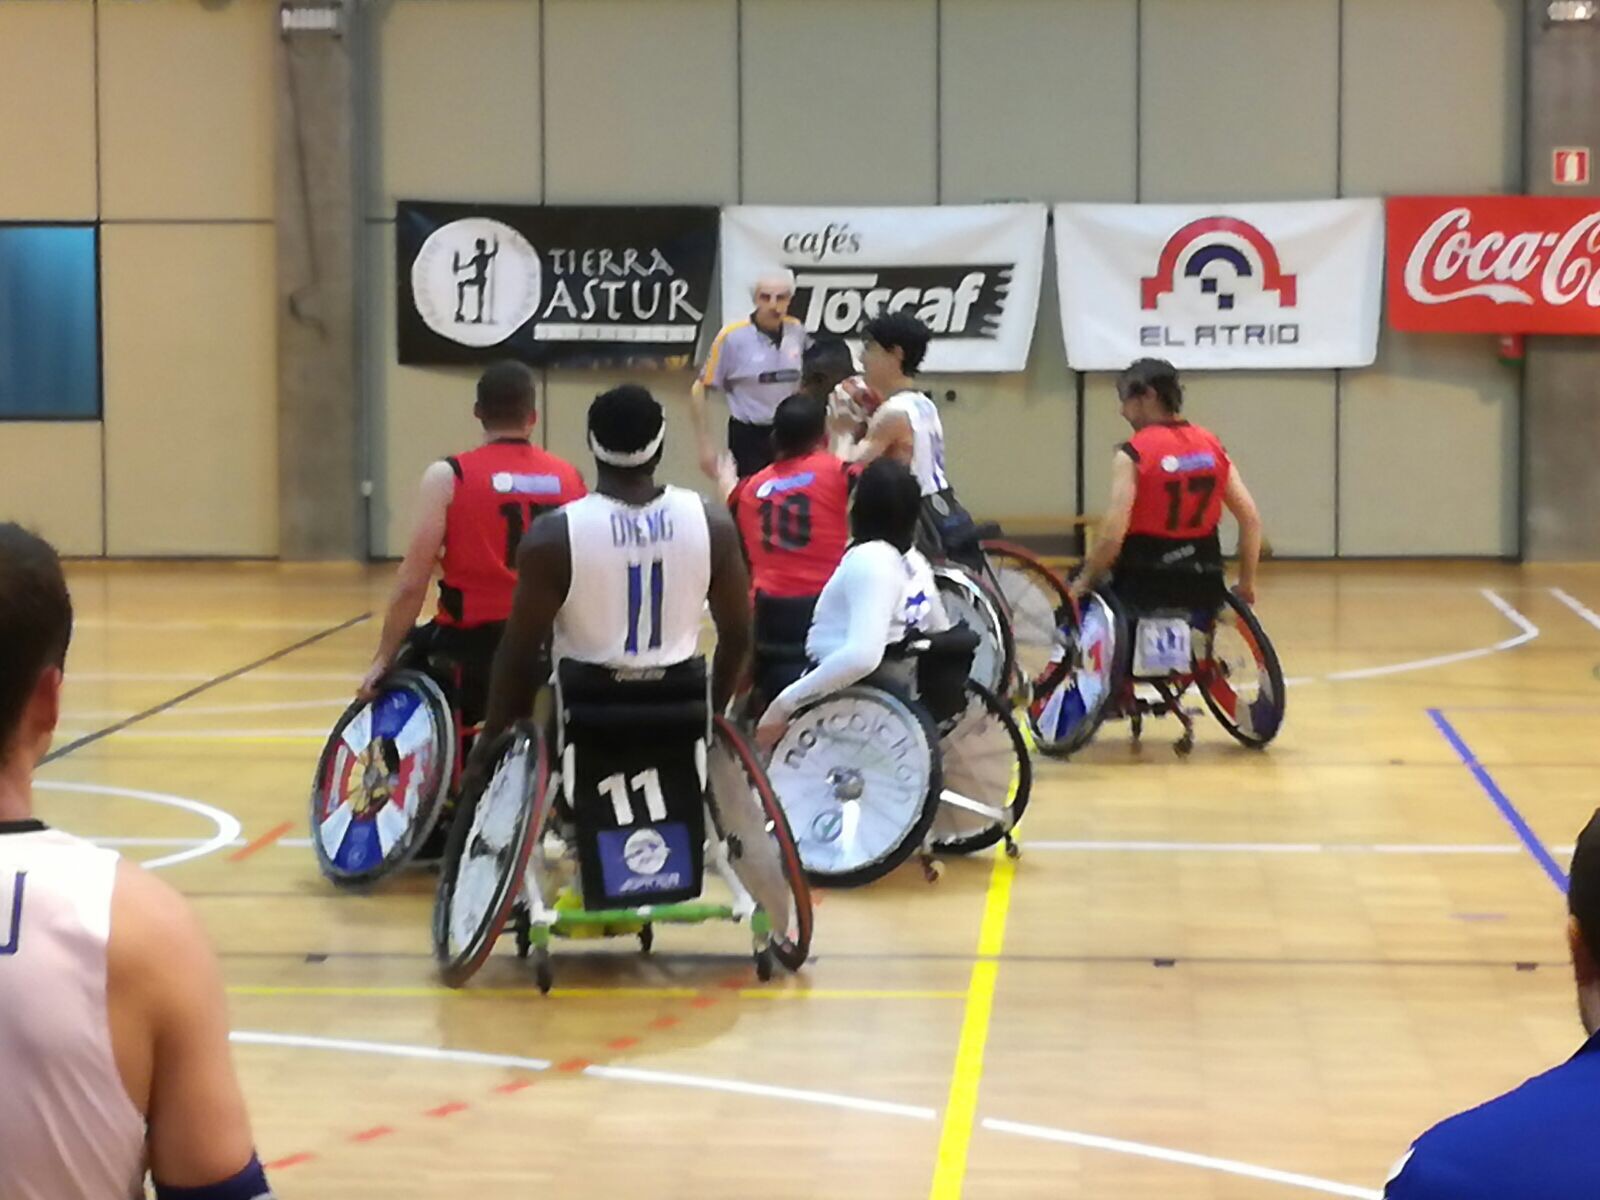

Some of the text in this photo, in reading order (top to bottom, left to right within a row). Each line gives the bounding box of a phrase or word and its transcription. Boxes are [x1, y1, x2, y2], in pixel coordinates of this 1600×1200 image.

[548, 247, 675, 277] TIERRA
[783, 222, 861, 262] cafés
[542, 278, 704, 322] ASTUR
[1140, 323, 1299, 347] EL ATRIO
[758, 492, 811, 554] 10
[1164, 475, 1216, 531] 17
[623, 558, 664, 656] 11
[597, 768, 668, 827] 11
